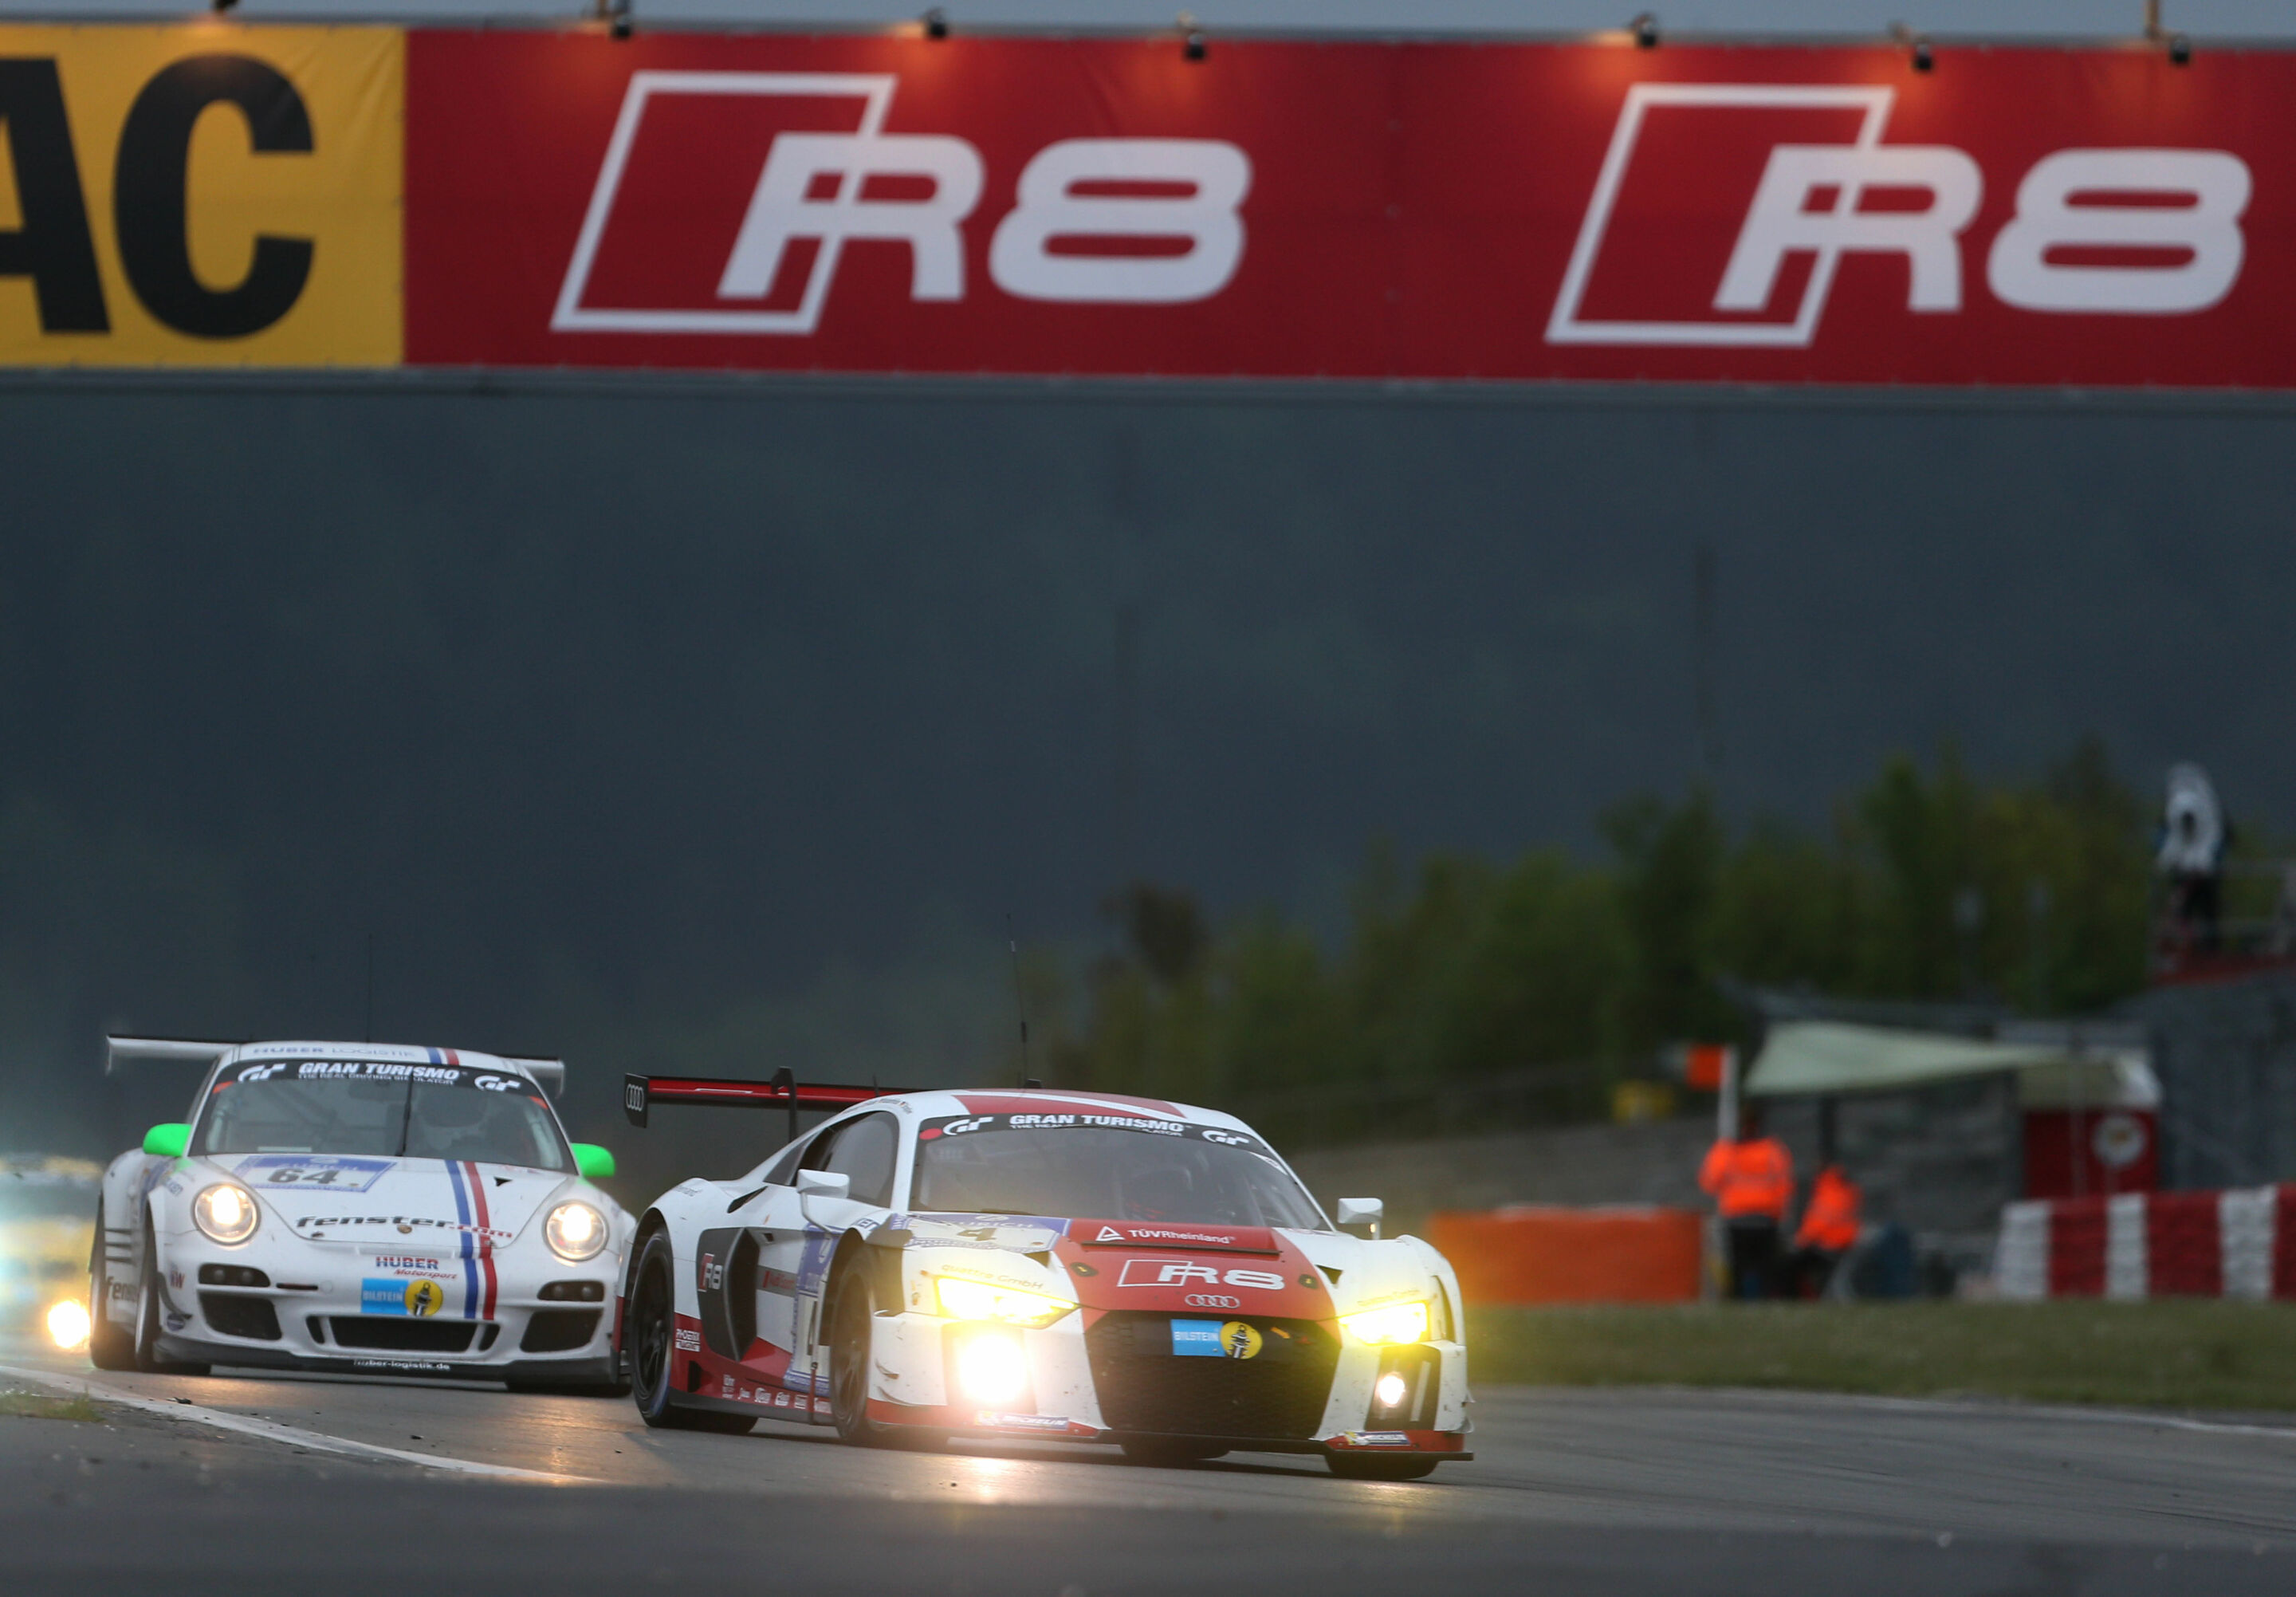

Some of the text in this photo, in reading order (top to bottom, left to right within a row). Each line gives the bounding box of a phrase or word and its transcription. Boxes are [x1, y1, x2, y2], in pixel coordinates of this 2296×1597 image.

[716, 131, 1252, 304] R8
[1712, 144, 2253, 314] R8
[298, 1062, 460, 1080] GRAN TURISMO
[1009, 1115, 1185, 1132] GRAN TURISMO
[267, 1168, 340, 1185] 64
[296, 1215, 513, 1238] fenster.com
[957, 1228, 997, 1242] 4
[375, 1256, 439, 1270] HUBER
[393, 1269, 458, 1280] Motorsport
[1157, 1265, 1286, 1290] R8
[362, 1289, 403, 1303] BILSTEIN
[1174, 1331, 1220, 1343] BILSTEIN
